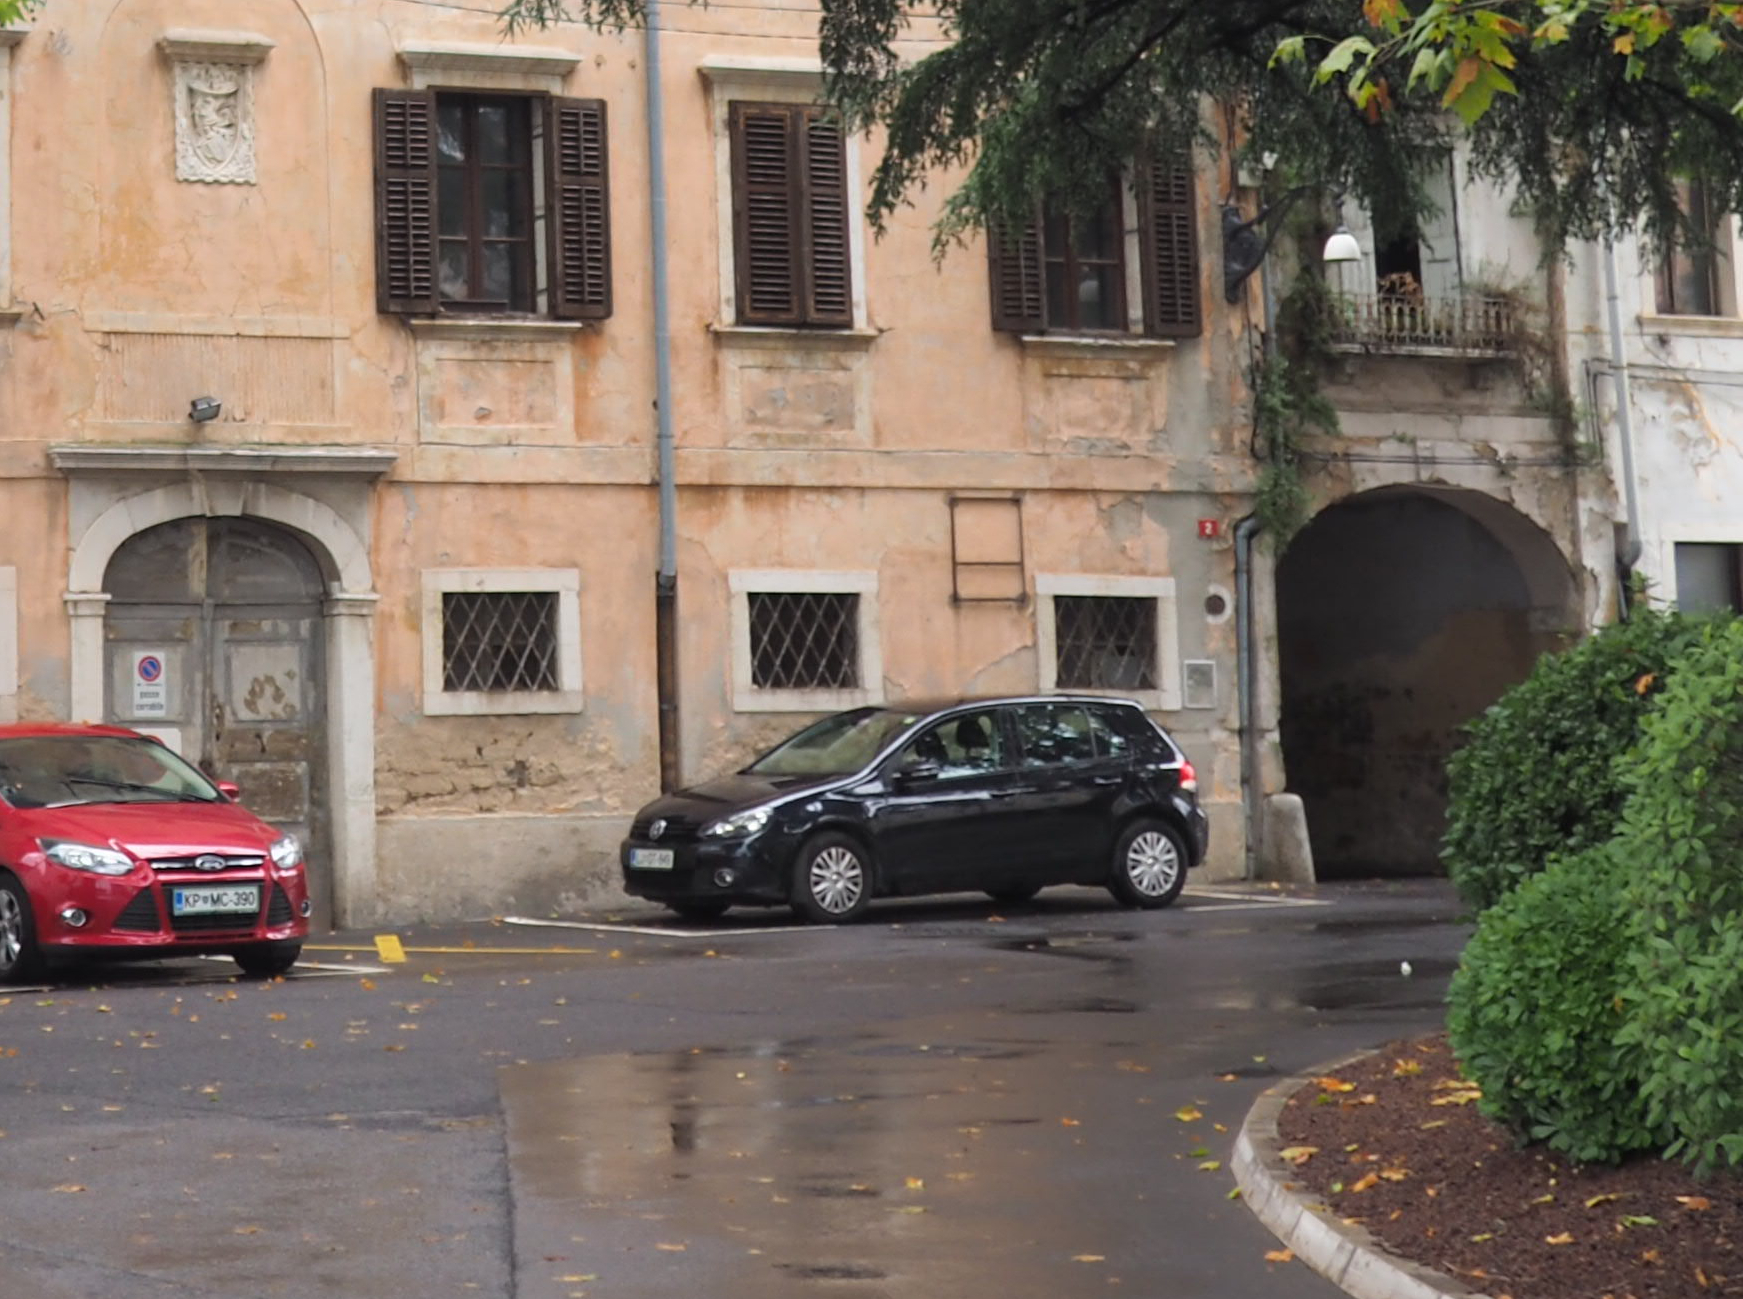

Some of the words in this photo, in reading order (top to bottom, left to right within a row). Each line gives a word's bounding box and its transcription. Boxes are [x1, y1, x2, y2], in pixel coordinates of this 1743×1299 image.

[1204, 522, 1213, 535] 2
[184, 893, 201, 908] KP
[210, 891, 255, 907] MC-390
